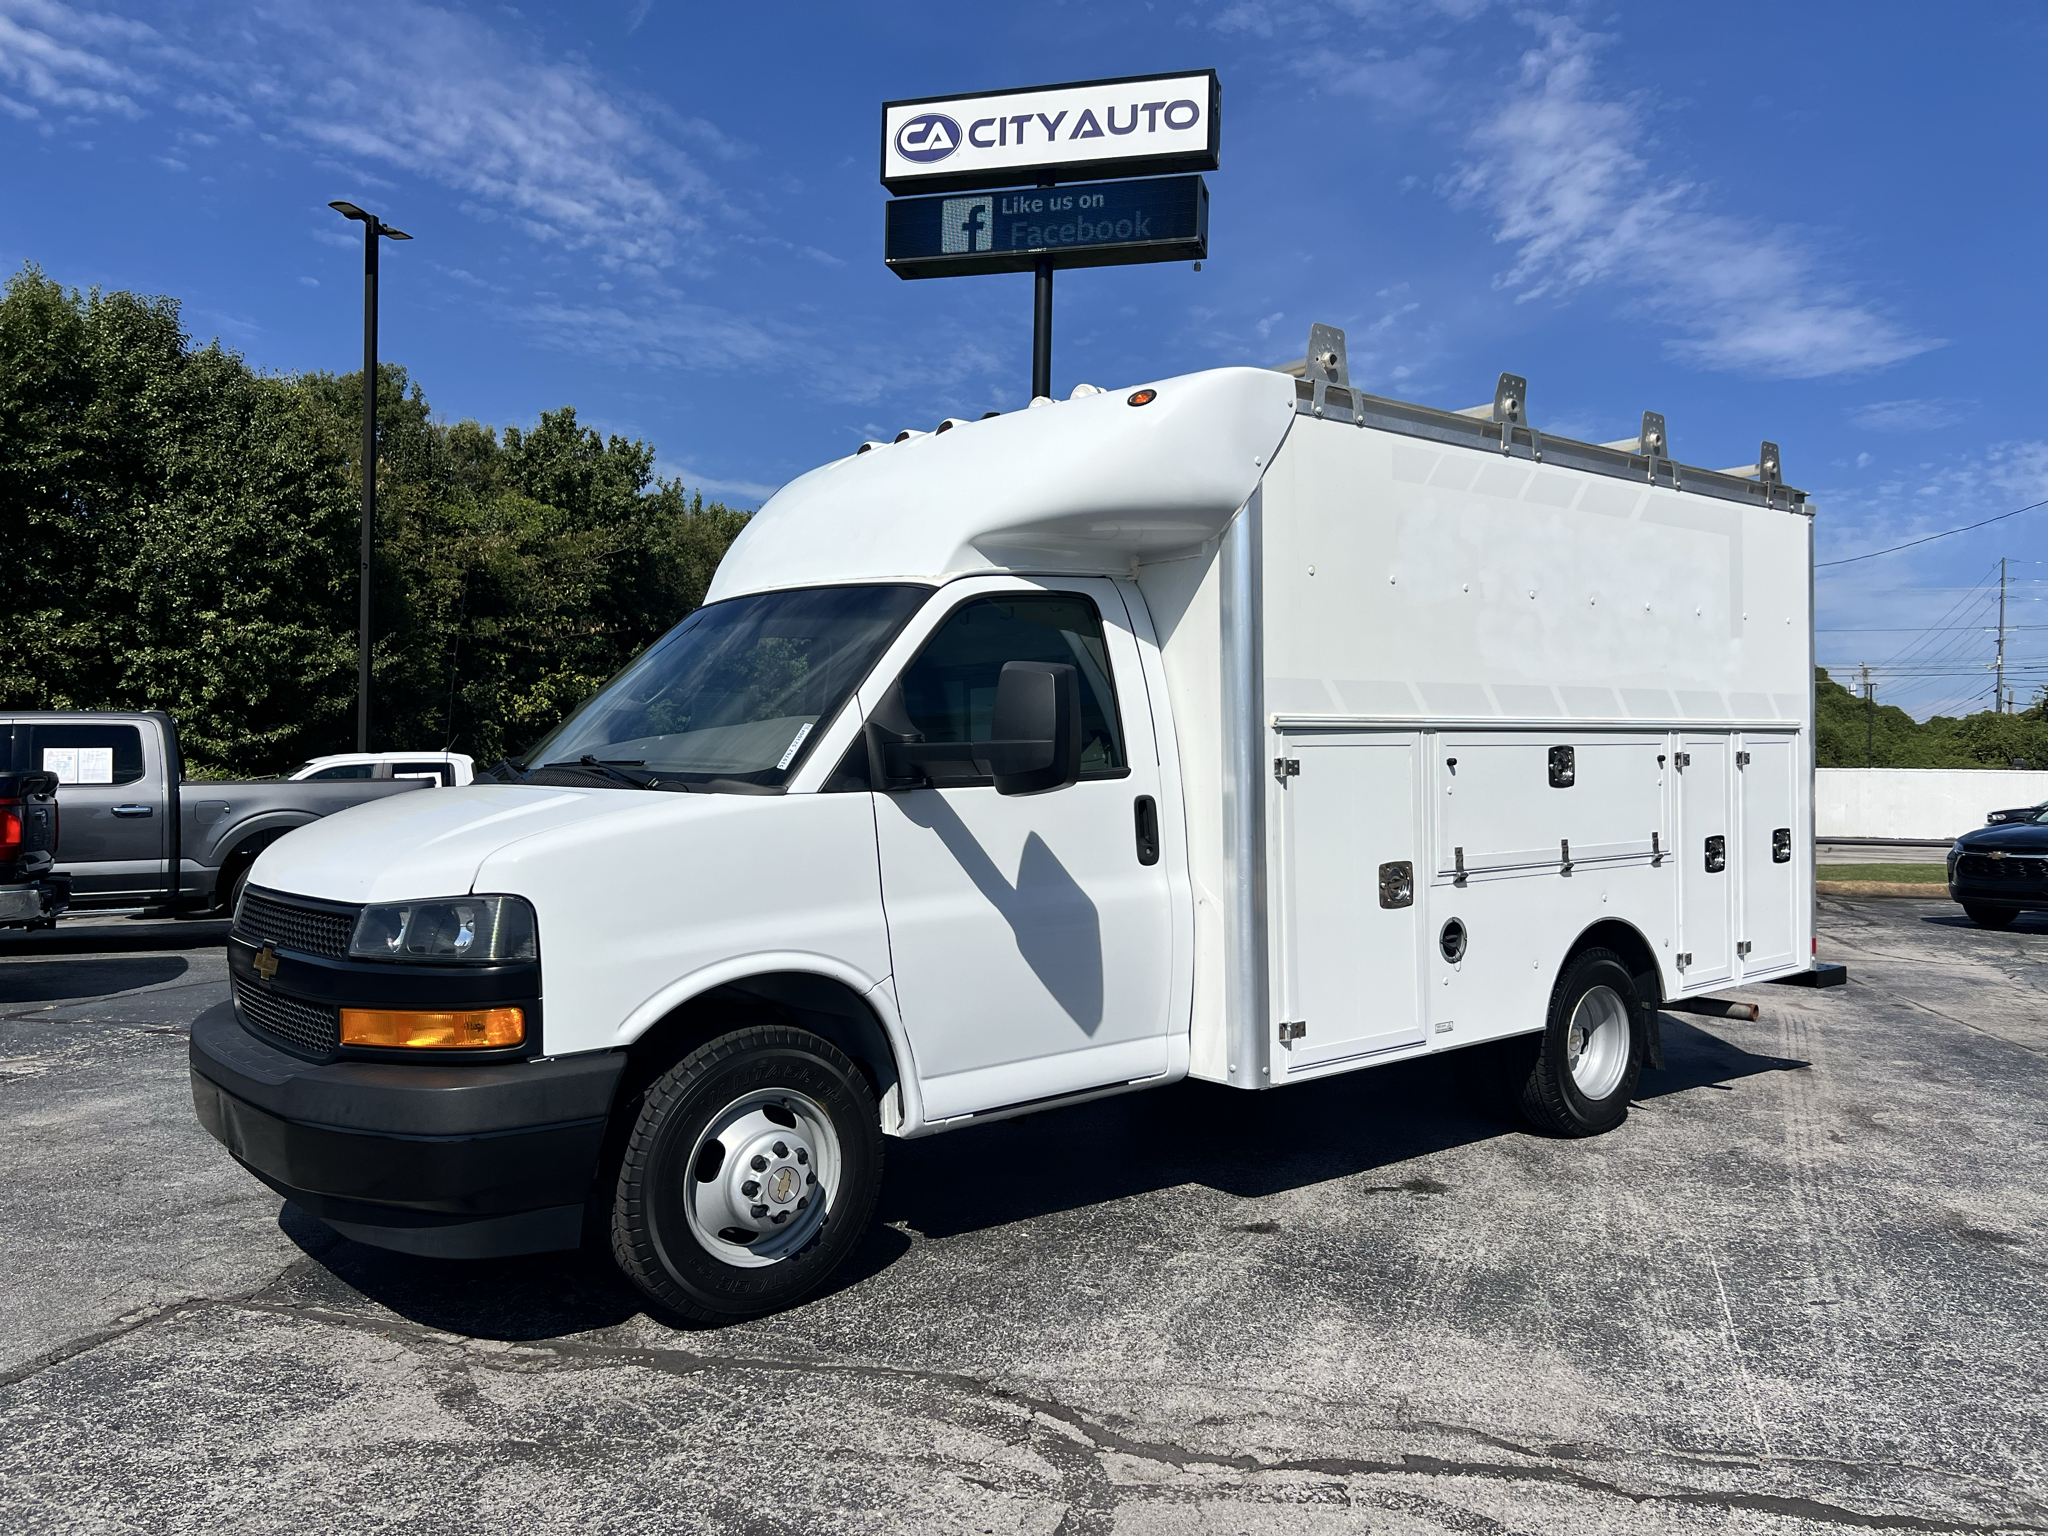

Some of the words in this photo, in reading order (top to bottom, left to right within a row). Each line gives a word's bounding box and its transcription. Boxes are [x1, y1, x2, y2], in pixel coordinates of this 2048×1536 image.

[1002, 195, 1044, 215] Like
[1050, 195, 1073, 211] us
[1078, 193, 1105, 209] on
[1011, 210, 1152, 247] Facebook
